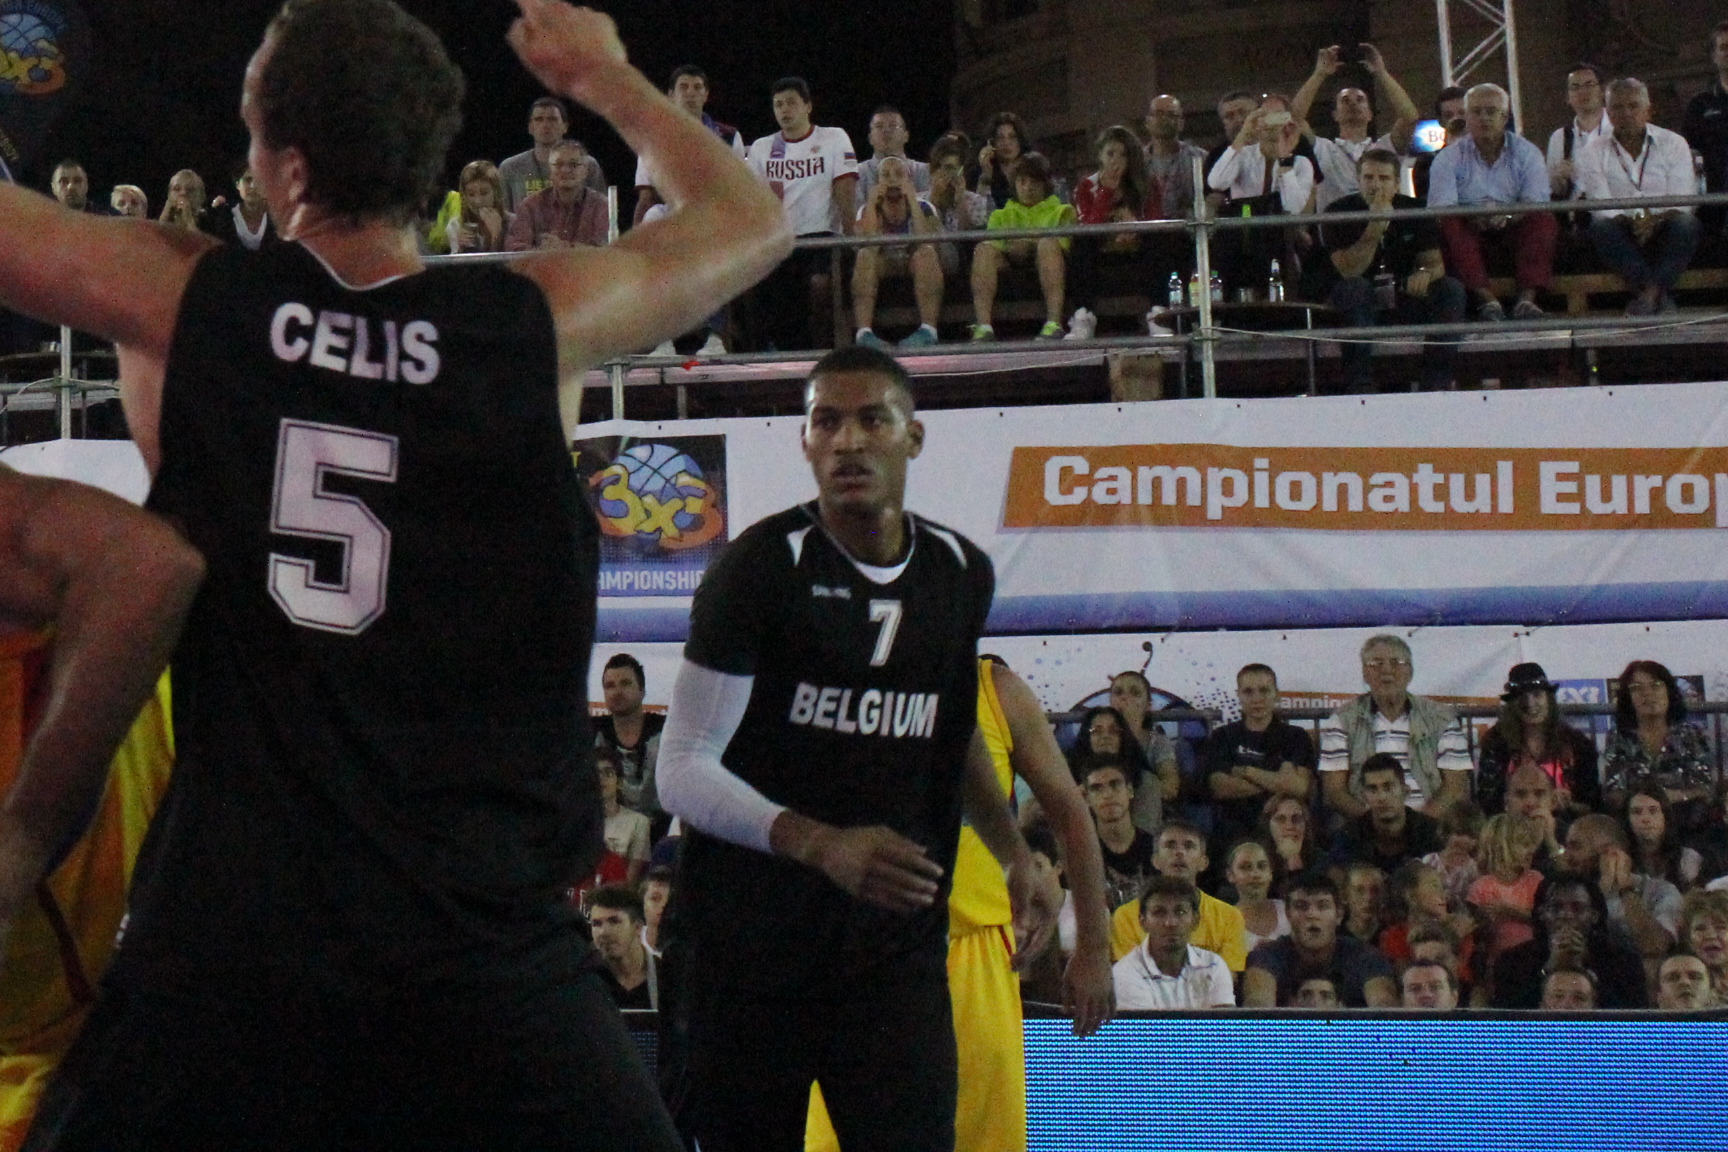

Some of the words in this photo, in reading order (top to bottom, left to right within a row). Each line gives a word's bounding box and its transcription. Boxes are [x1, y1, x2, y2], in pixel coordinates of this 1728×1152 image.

[766, 157, 825, 180] RUSSIA
[270, 302, 441, 385] CELIS
[267, 417, 399, 636] 5
[1044, 455, 1513, 520] Campionatul
[1540, 460, 1728, 528] Euro
[869, 599, 903, 667] 7
[789, 682, 939, 738] BELGIUM
